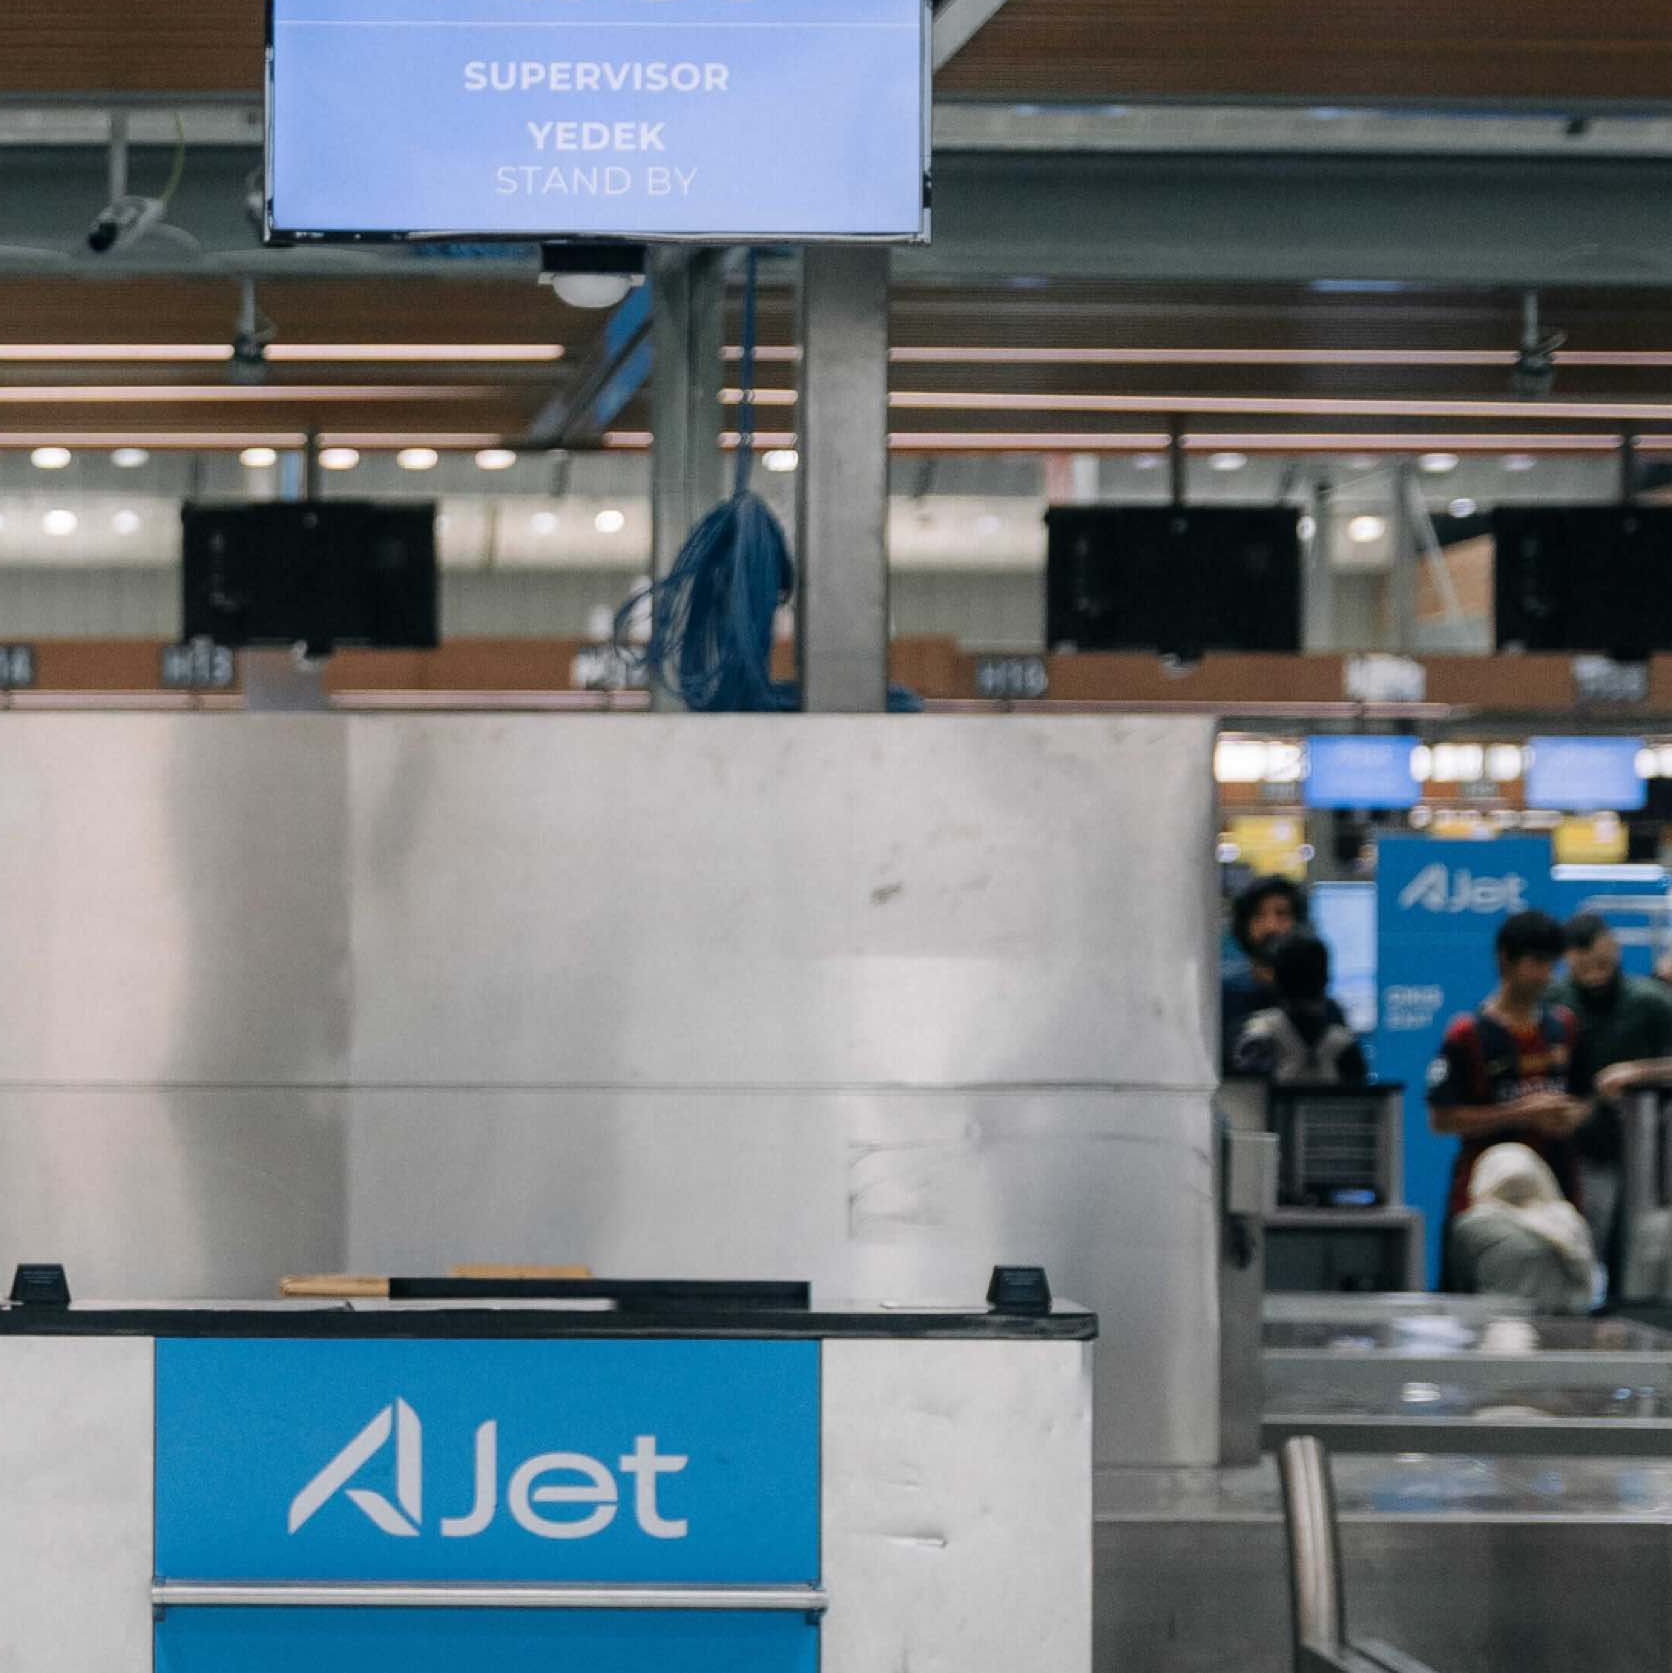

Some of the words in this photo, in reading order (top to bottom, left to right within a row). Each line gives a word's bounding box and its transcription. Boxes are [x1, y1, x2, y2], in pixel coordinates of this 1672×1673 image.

[463, 61, 730, 92] SUPERVISOR
[527, 120, 666, 151] YEDEK
[495, 165, 632, 196] STAND
[647, 165, 698, 196] BY
[287, 1395, 689, 1540] AJet
